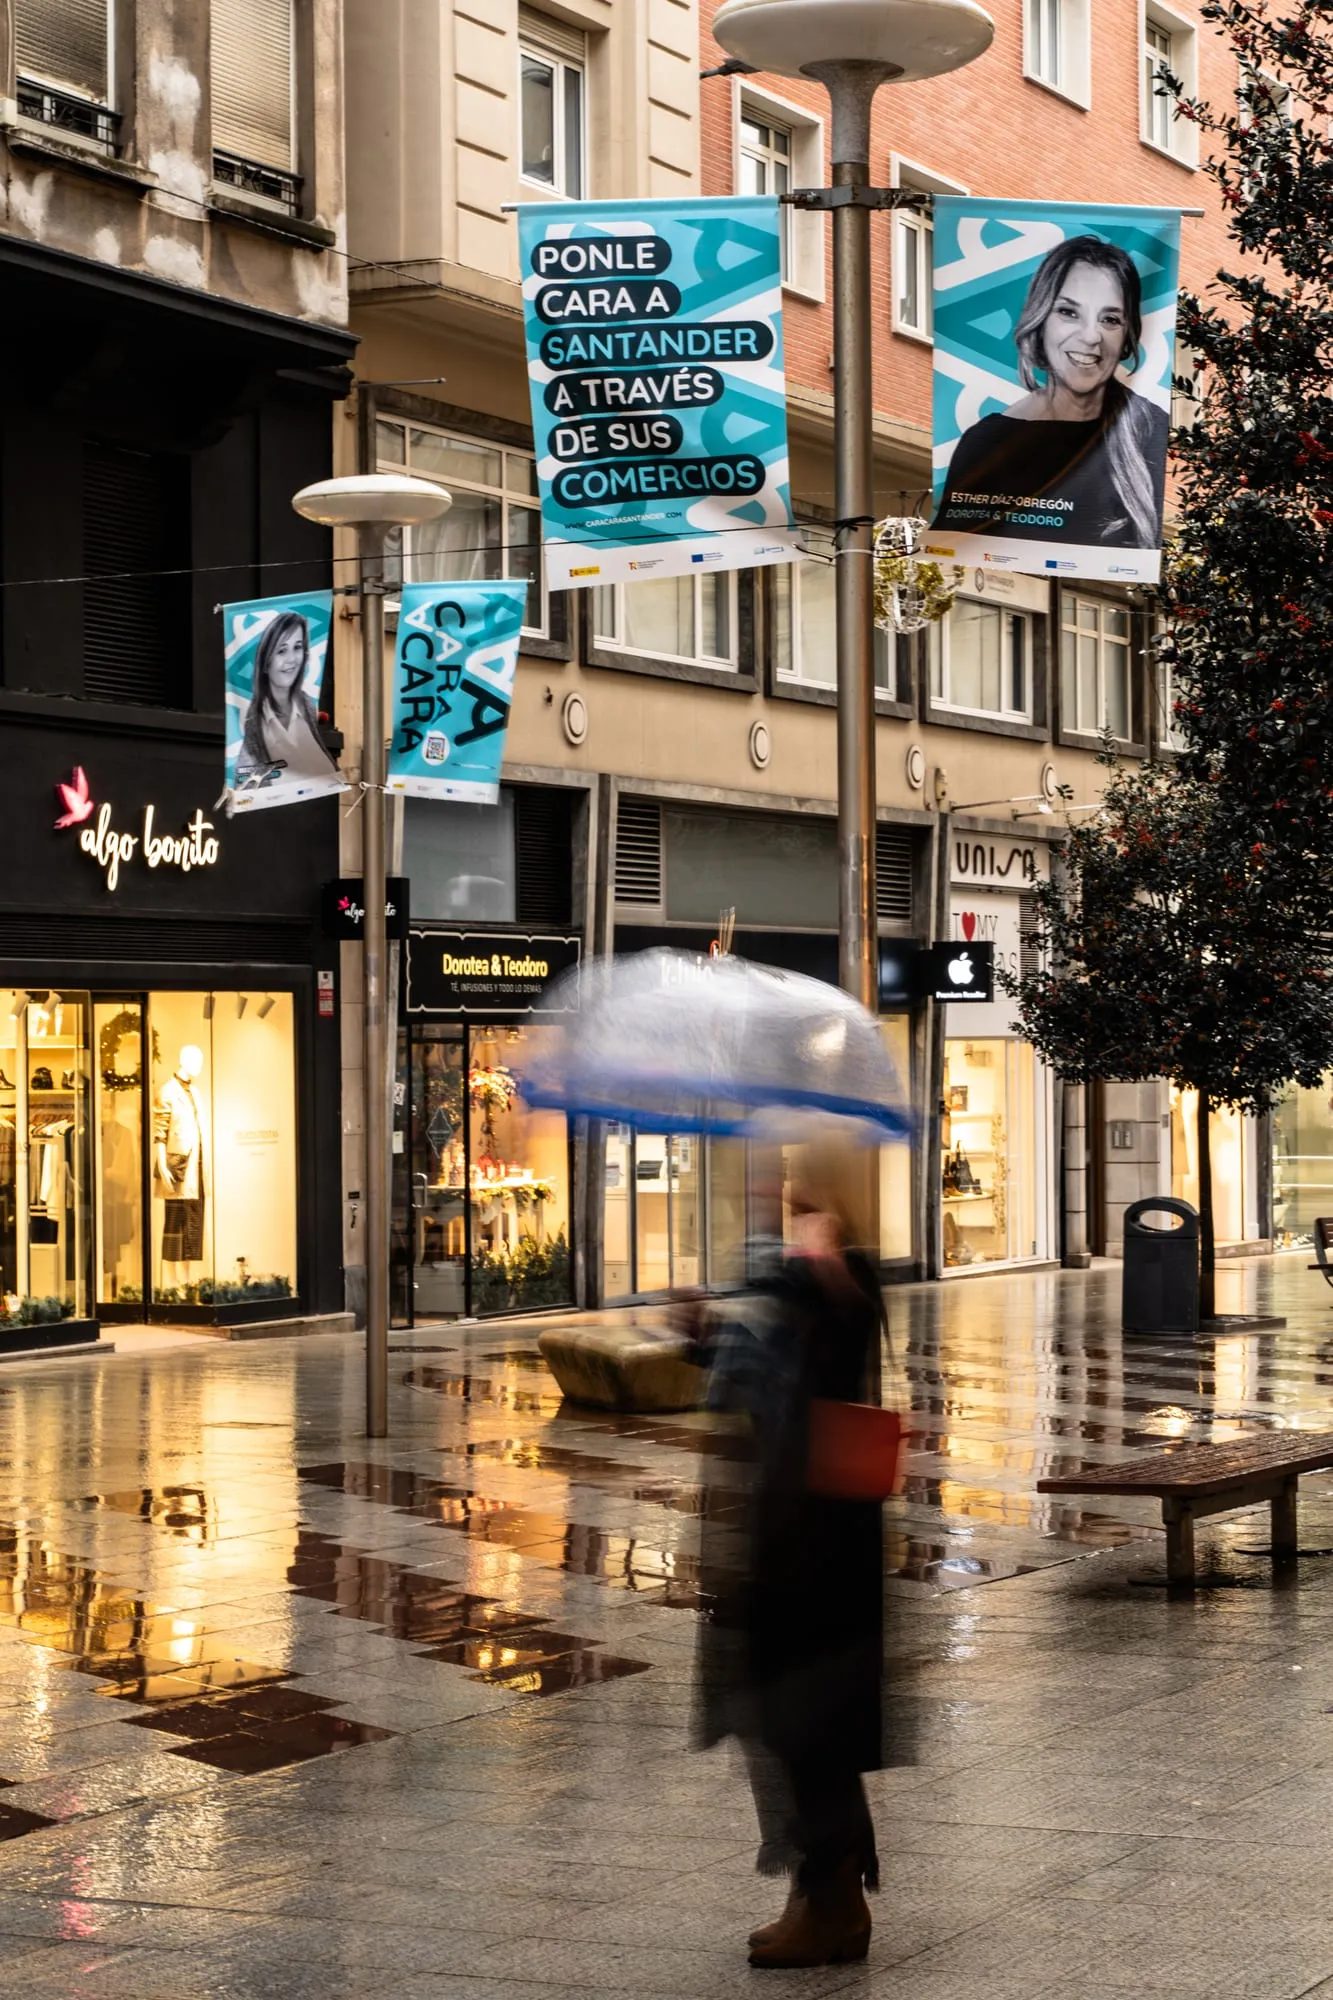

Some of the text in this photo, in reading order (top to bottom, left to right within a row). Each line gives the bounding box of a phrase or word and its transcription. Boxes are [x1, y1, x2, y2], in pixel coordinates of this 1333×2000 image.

[539, 242, 655, 274] PONLE
[542, 287, 670, 318] CARA A
[547, 328, 758, 364] SANTANDER
[553, 367, 714, 412] A TRAVÉS
[556, 421, 672, 457] DE SUS
[560, 460, 757, 500] COMERCIOS
[945, 508, 1064, 527] DOROTEA & TEODORO
[951, 491, 1075, 512] ESTHER DÍAZ-OBREGÓN
[427, 600, 466, 725] CARA
[398, 632, 435, 754] CARA
[80, 803, 219, 892] algo bonito
[956, 842, 1036, 882] UNISA
[344, 902, 365, 924] algo
[977, 914, 998, 942] MY
[443, 953, 548, 977] Dorotea & Teodoro
[461, 982, 493, 993] INFUSIONES
[499, 983, 514, 993] TODO
[515, 984, 522, 993] LO
[523, 982, 542, 994] DEMÁS
